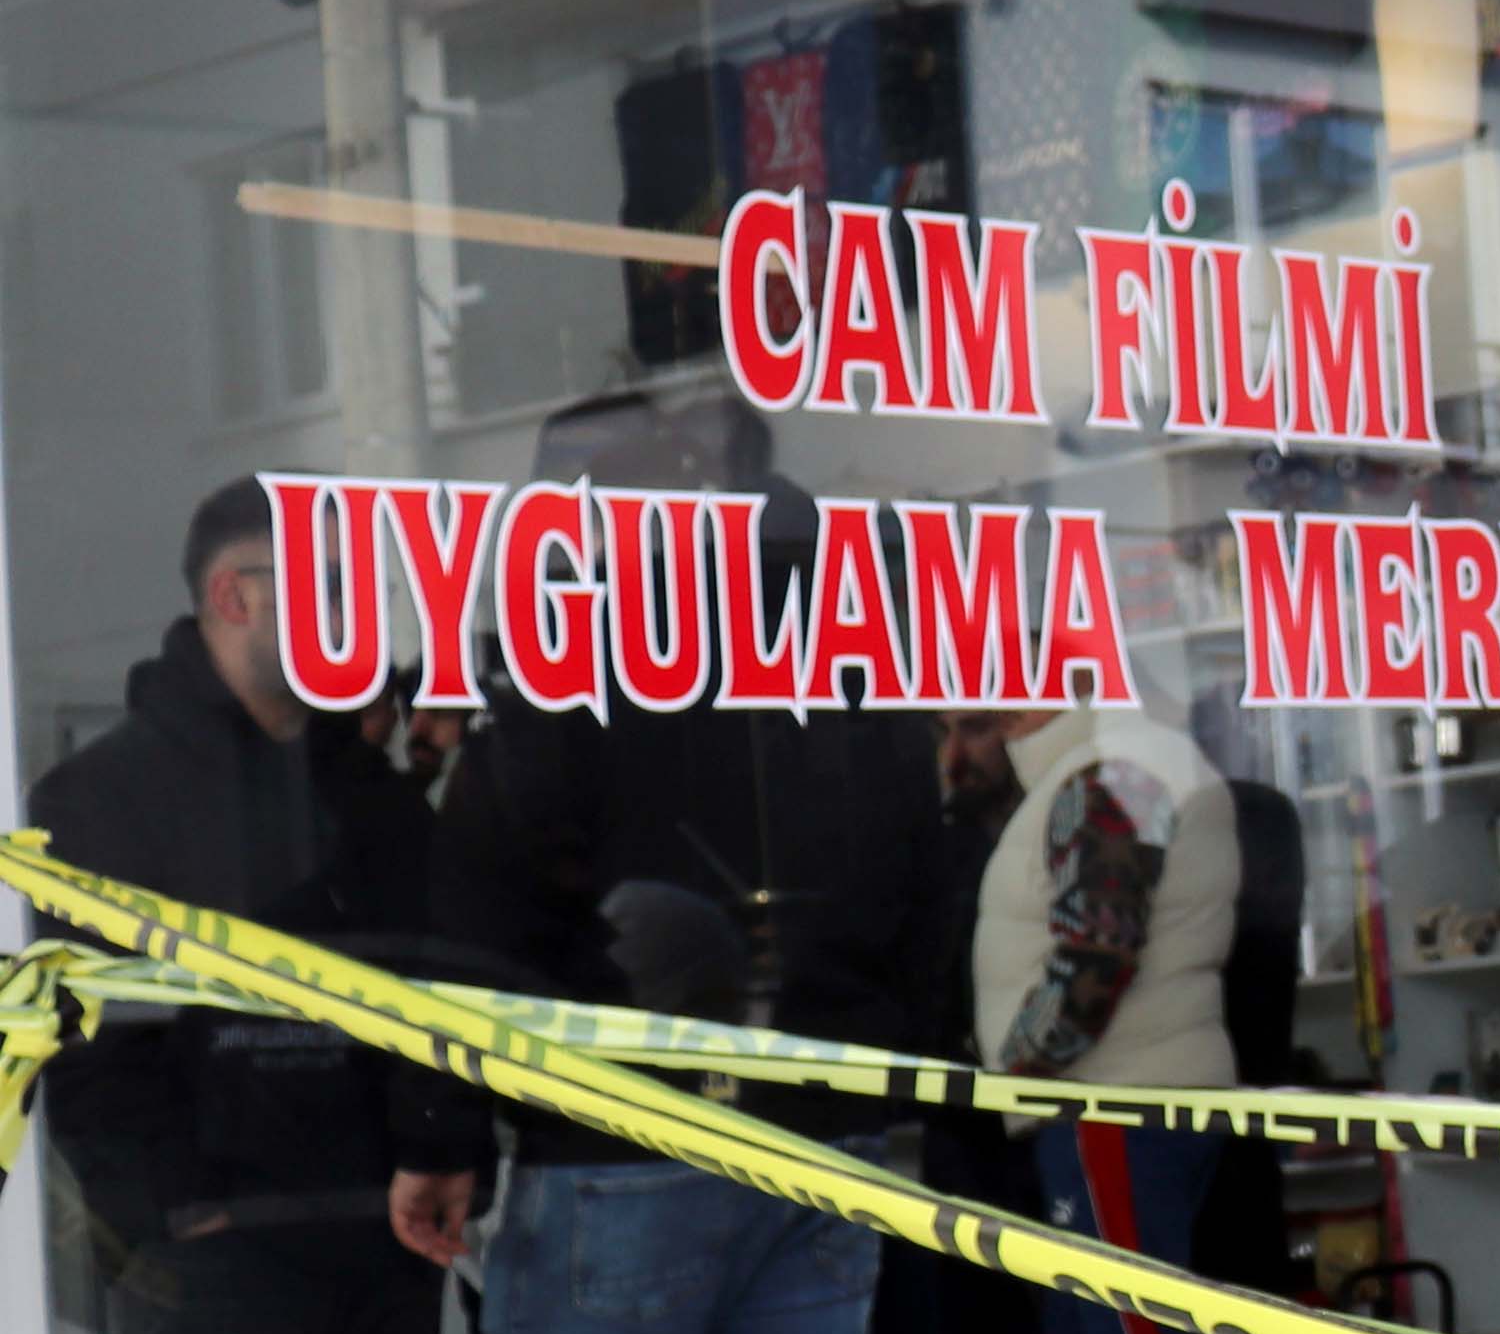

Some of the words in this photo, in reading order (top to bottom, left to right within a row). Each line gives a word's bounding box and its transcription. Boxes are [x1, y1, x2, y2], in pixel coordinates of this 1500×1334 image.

[717, 184, 1050, 425] CAM
[1077, 176, 1443, 455] FİLMİ
[255, 470, 1145, 723] UYGULAMA
